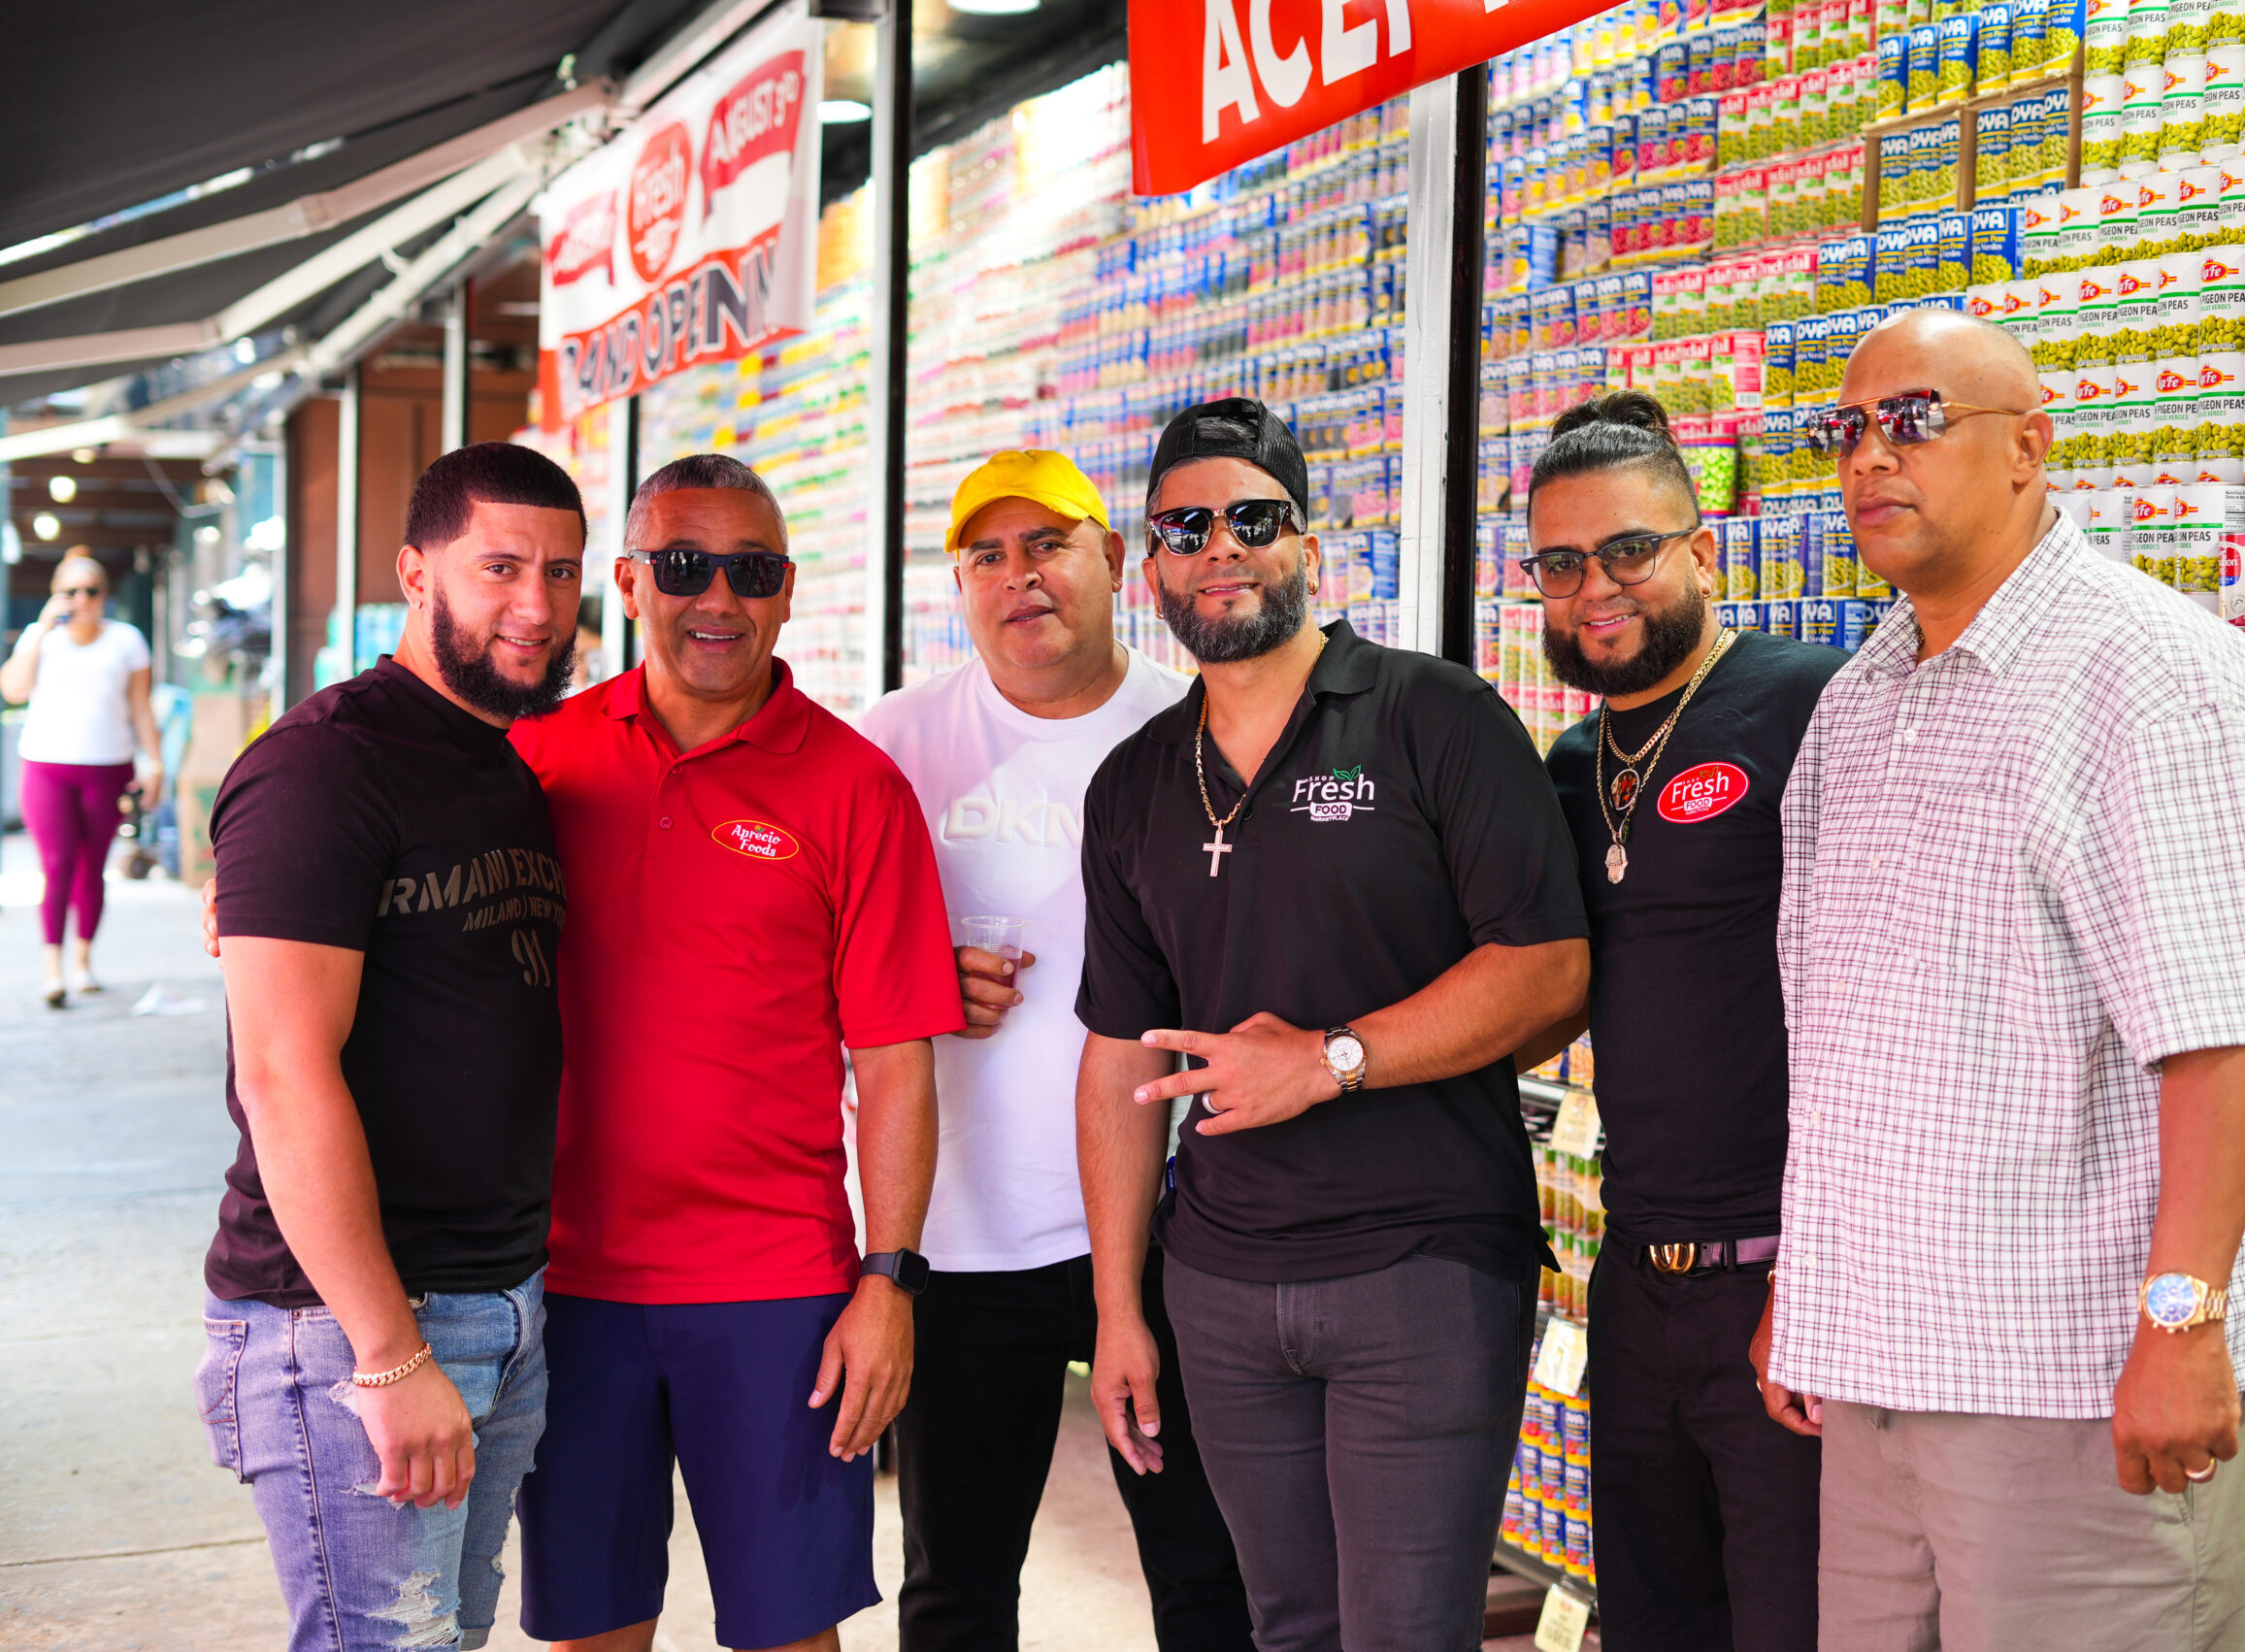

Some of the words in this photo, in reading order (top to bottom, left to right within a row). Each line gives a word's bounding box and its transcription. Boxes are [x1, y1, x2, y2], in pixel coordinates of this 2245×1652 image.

[2144, 14, 2166, 22] PEAS
[2101, 23, 2122, 32] PEAS
[2219, 90, 2240, 100] PEAS
[2175, 100, 2196, 109] PEAS
[2135, 109, 2157, 117] PEAS
[2096, 117, 2115, 126] PEAS
[2196, 211, 2219, 221] PEAS
[2156, 216, 2177, 226] PEAS
[2072, 232, 2092, 241] PEAS
[2228, 292, 2245, 303] PEA
[2168, 300, 2188, 309] PEAS
[2140, 306, 2158, 315] PEA
[2101, 311, 2117, 320] PEA
[2052, 317, 2072, 326] PEAS
[2158, 404, 2183, 413] PIGEON
[2129, 409, 2150, 418] PEAS
[2094, 535, 2110, 545] PEAS
[2157, 533, 2174, 543] PEA
[2189, 531, 2211, 542] PEAS
[1292, 774, 1374, 803] Fresh
[1671, 771, 1730, 804] Fresh
[1685, 798, 1709, 809] FOOD
[1315, 805, 1347, 814] FOOD
[731, 824, 782, 844] Aprecio
[740, 838, 776, 857] Foods
